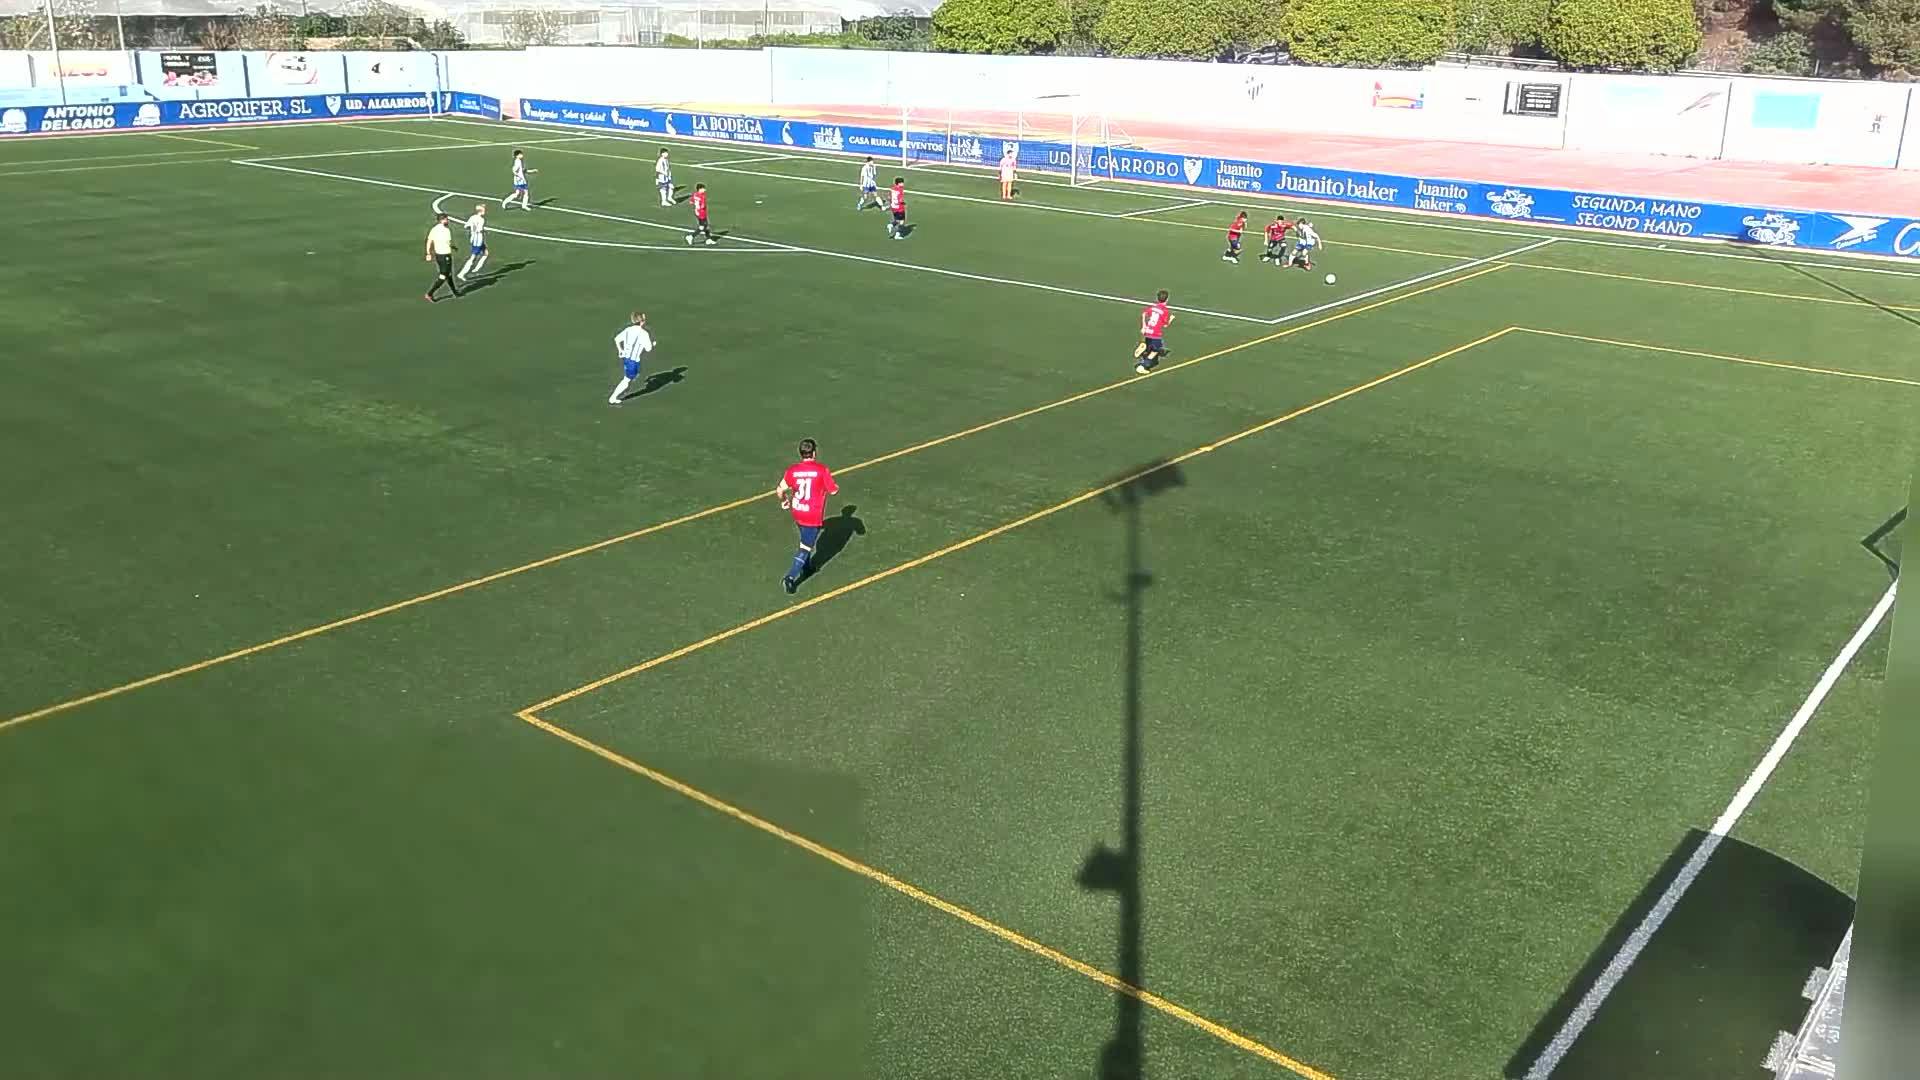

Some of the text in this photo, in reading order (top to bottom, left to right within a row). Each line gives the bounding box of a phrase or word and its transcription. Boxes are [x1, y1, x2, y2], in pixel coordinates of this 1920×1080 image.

[44, 104, 115, 119] ANTONIO
[179, 99, 312, 119] AGRORIFER, SL
[368, 98, 434, 110] ALGARROBO
[41, 117, 116, 131] DELGADO
[692, 115, 708, 130] LA
[710, 117, 763, 135] BODEGA
[849, 136, 869, 145] CASA
[871, 137, 897, 148] RURAL
[906, 140, 943, 151] EVENTOS
[1049, 151, 1179, 177] UD ALGARROBO
[1217, 160, 1262, 178] Juanito
[1217, 174, 1250, 190] baker
[1276, 170, 1399, 202] Juanito baker
[1414, 180, 1468, 200] Juanito
[1414, 195, 1454, 212] baker
[1572, 195, 1702, 219] SEGUNDA MANO
[1575, 212, 1693, 236] SECOND HAND
[795, 478, 811, 500] 31
